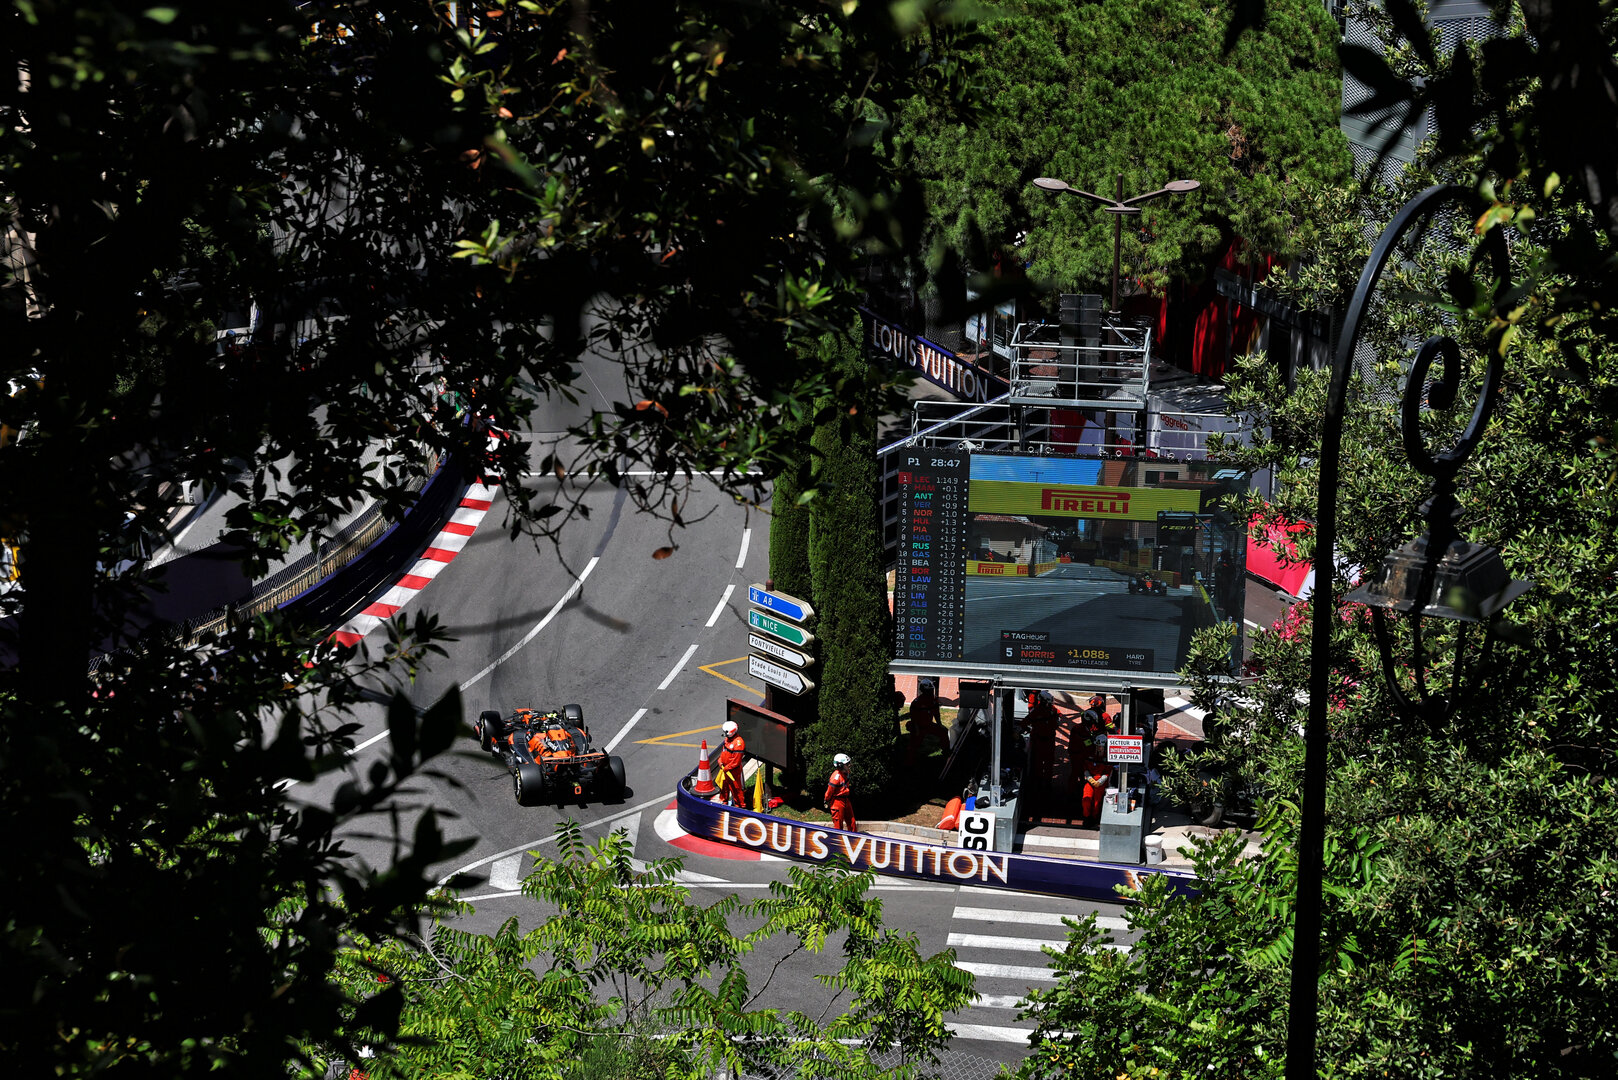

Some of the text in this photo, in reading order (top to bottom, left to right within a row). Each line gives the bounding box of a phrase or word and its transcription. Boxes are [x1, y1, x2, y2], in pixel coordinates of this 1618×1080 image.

[874, 320, 916, 366] LOUIS
[920, 344, 988, 403] VUITTON
[1160, 414, 1188, 430] aggreko
[908, 458, 960, 467] P1 28:47
[1041, 489, 1131, 514] PIRELLI
[763, 595, 773, 606] A8
[762, 619, 778, 632] NICE
[751, 638, 784, 656] FONTVIEILLE
[1006, 648, 1013, 657] 5
[1021, 650, 1055, 659] NORRIS
[1068, 649, 1110, 659] +1.088s
[751, 659, 766, 670] Stade
[768, 666, 781, 676] Louis
[963, 817, 989, 850] SC
[722, 811, 1009, 884] LOUIS VUITTON
